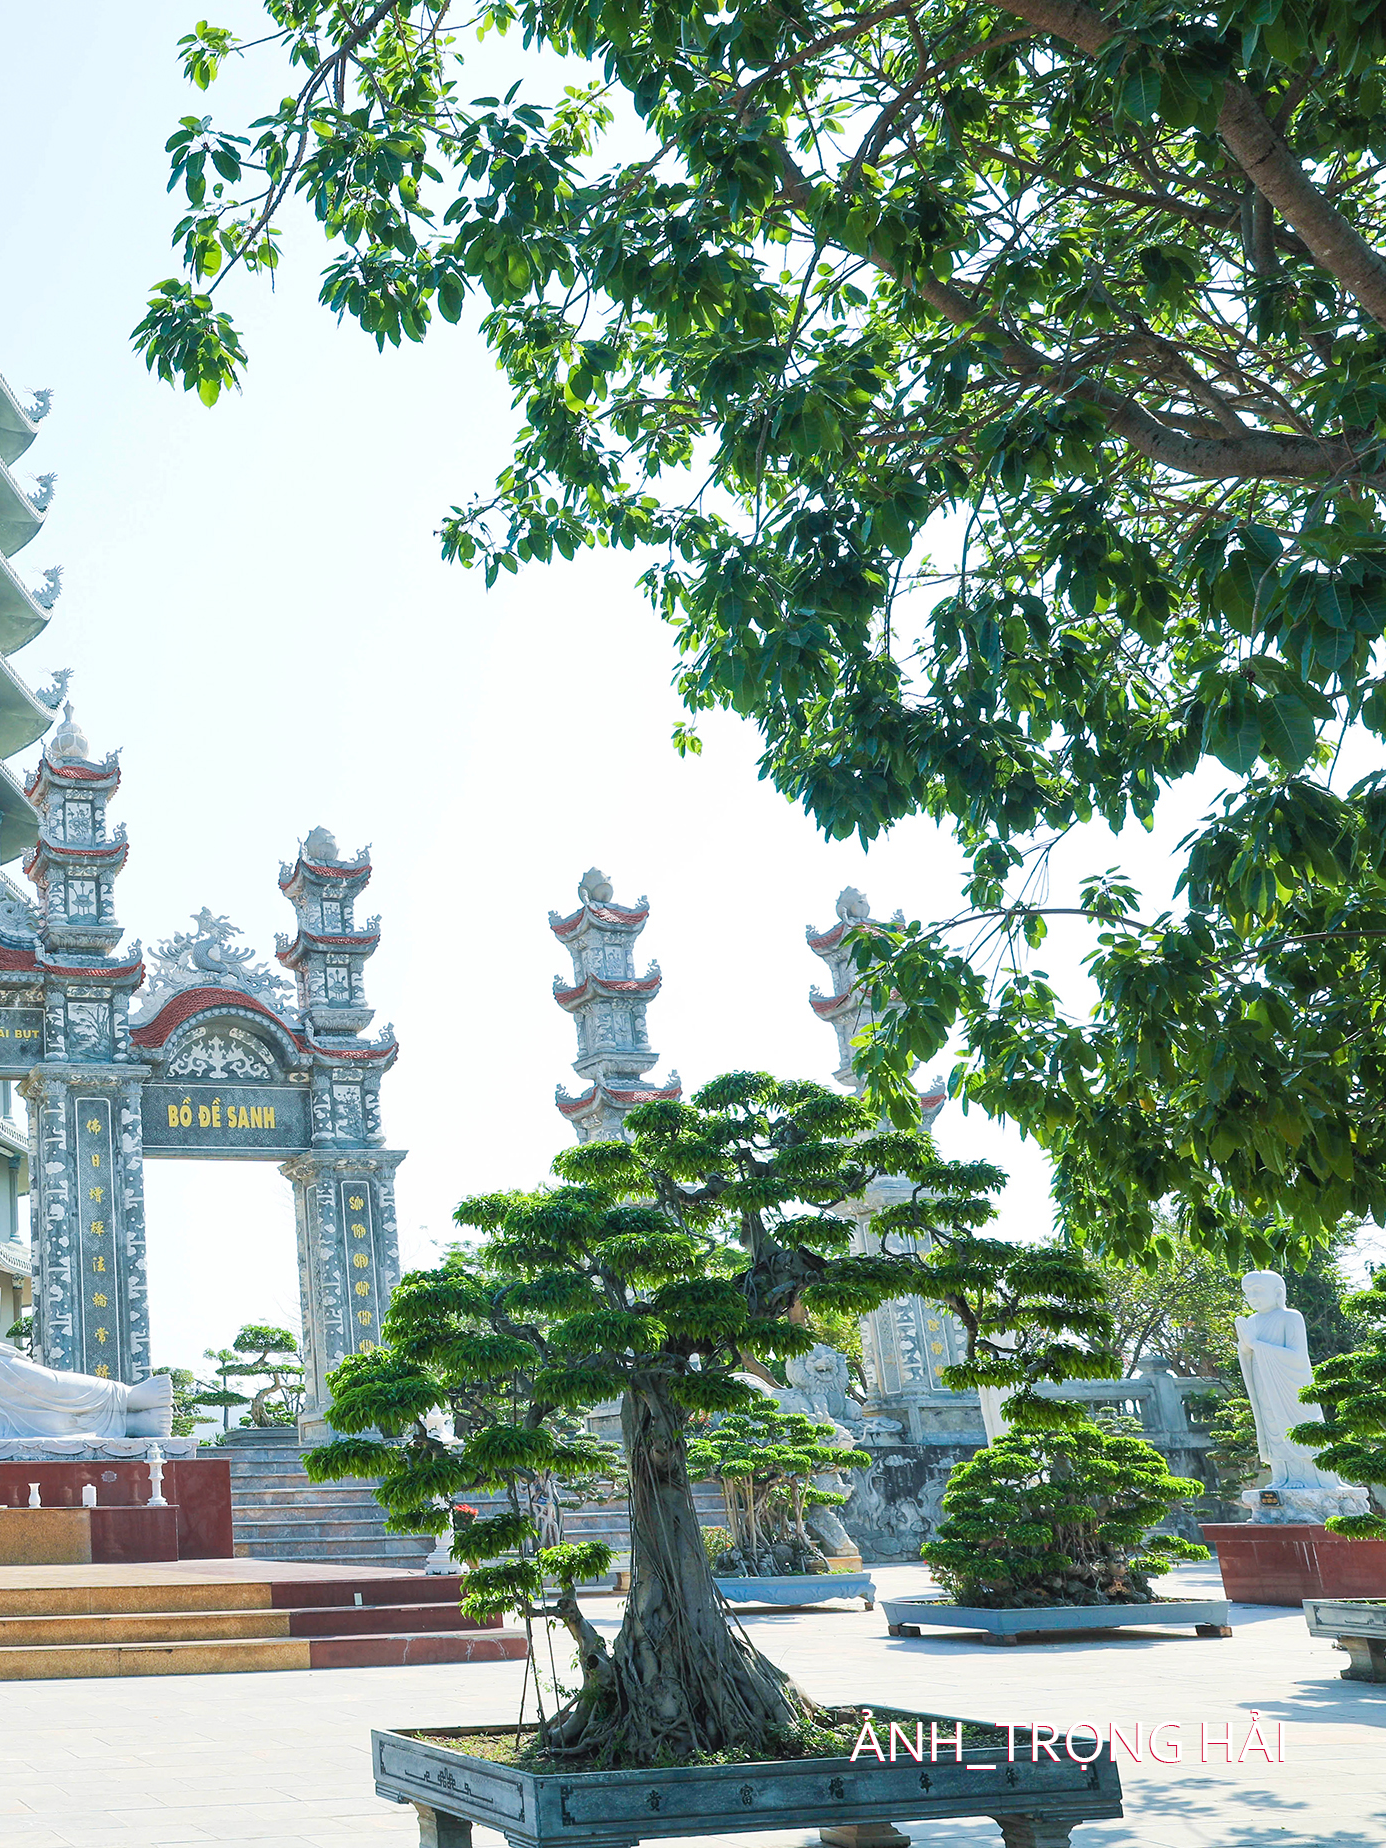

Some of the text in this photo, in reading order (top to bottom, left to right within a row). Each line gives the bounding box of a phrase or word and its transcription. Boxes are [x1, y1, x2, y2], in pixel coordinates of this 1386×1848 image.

[14, 1029, 40, 1041] BỤT
[167, 1096, 276, 1129] BỒ ĐỀ SANH
